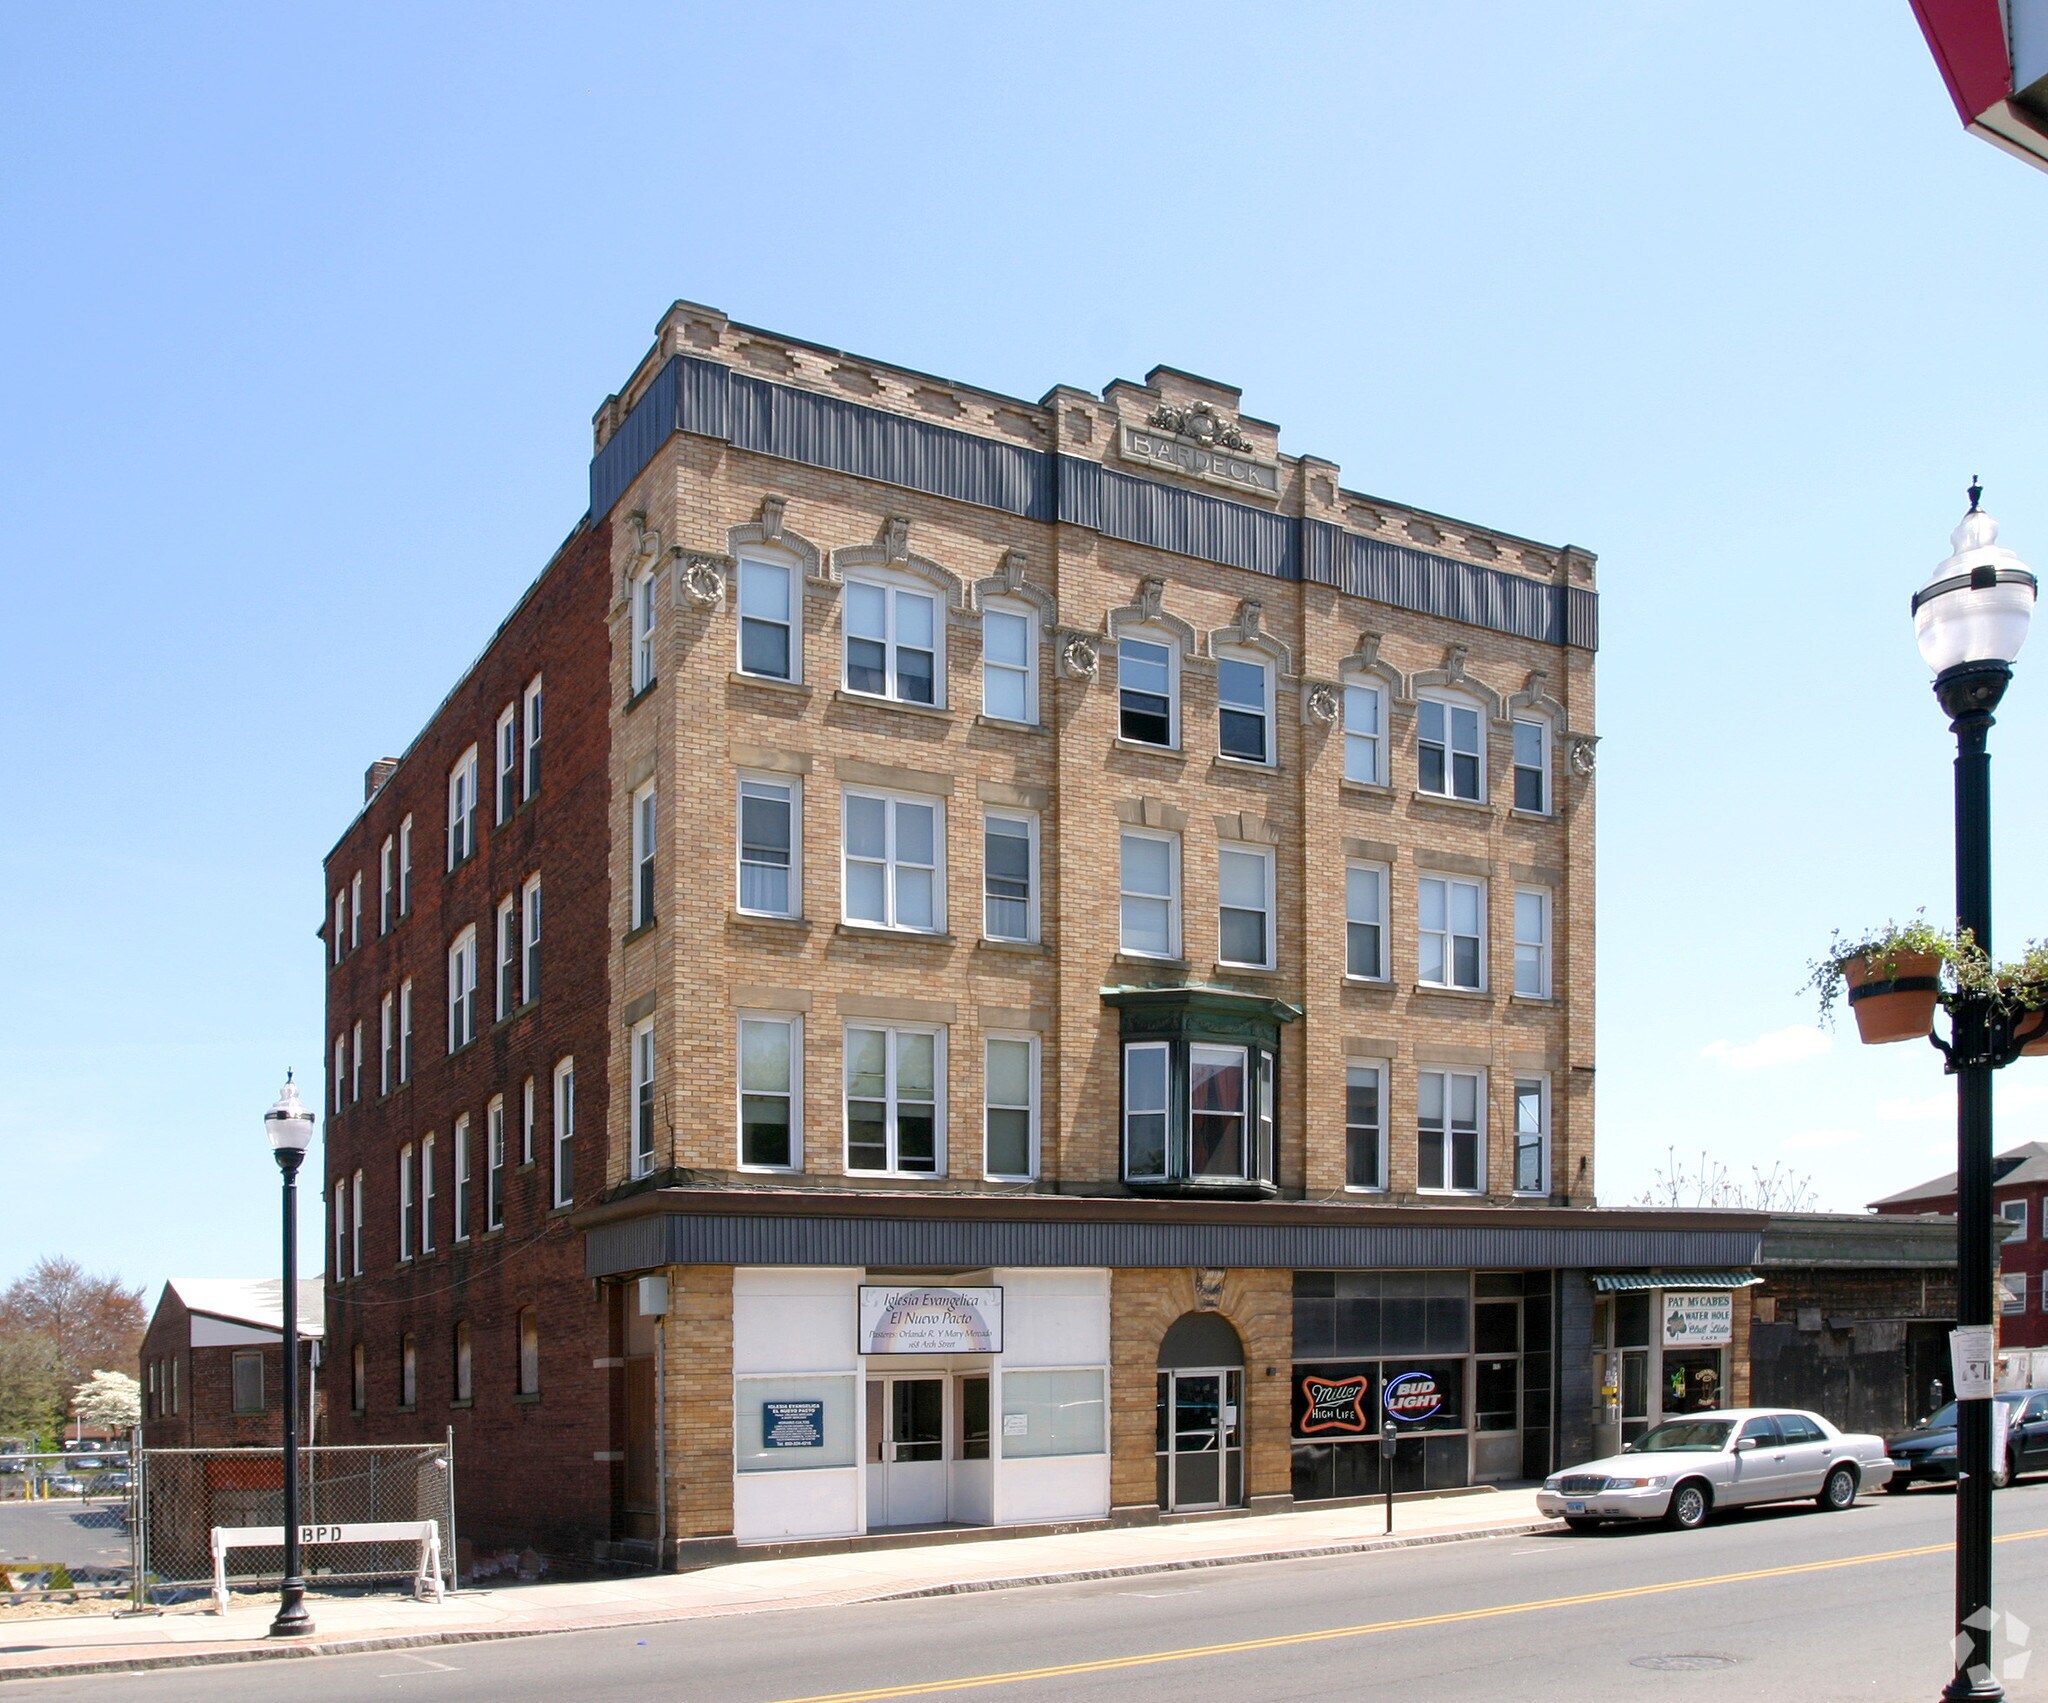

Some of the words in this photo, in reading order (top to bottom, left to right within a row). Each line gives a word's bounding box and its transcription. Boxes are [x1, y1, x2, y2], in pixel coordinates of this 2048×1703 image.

[884, 1293, 919, 1312] Iglesia
[922, 1294, 979, 1312] Evangelica
[1668, 1297, 1684, 1307] PAT
[890, 1312, 902, 1325] El
[904, 1312, 940, 1325] Nuevo
[942, 1312, 972, 1325] Pacto
[1685, 1311, 1708, 1320] WATER
[1712, 1311, 1729, 1320] HOLE
[899, 1330, 927, 1338] Orlando
[938, 1330, 943, 1338] Y
[944, 1330, 964, 1339] Mary
[965, 1330, 992, 1338] Mercado
[922, 1340, 937, 1348] Arch
[938, 1341, 955, 1349] Street
[1311, 1384, 1361, 1403] Miller
[1396, 1381, 1436, 1396] BUD
[1388, 1394, 1442, 1411] LIGHT
[302, 1527, 342, 1542] BPD
